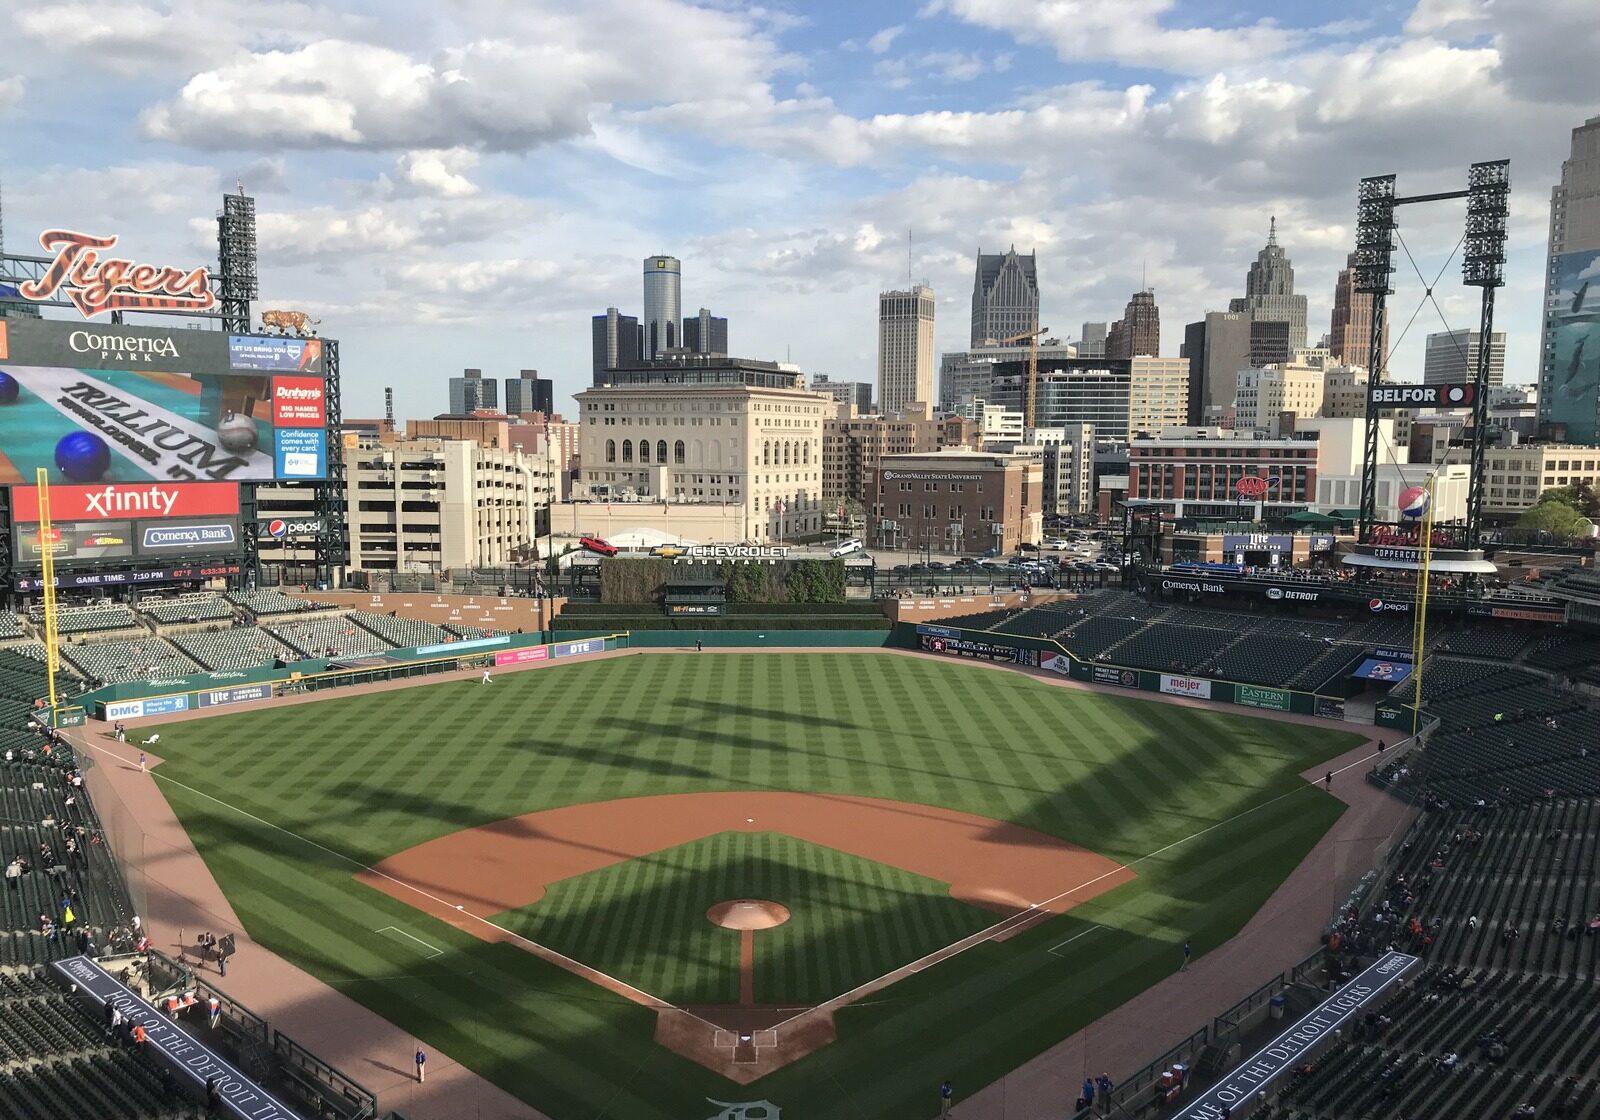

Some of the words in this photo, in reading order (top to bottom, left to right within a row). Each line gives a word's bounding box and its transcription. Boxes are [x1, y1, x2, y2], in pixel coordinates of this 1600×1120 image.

[20, 229, 215, 318] Tigers
[1223, 313, 1239, 321] 1001
[101, 352, 153, 362] PARK
[276, 386, 321, 398] Dunham's
[1372, 388, 1437, 402] BELFOR
[60, 381, 249, 479] TRILLIUM
[280, 430, 319, 438] Confidence
[948, 473, 983, 481] UNIVERSITY
[85, 486, 179, 516] xfinity
[287, 520, 321, 535] pepsi
[201, 529, 228, 539] Bank
[1249, 534, 1269, 545] Lite
[692, 546, 791, 557] CHEVROLET
[76, 576, 100, 584] GAME
[103, 574, 126, 582] TIME:
[151, 571, 164, 579] PM
[1202, 583, 1225, 593] Bank
[1019, 595, 1028, 603] 42
[1285, 591, 1319, 601] DETROIT
[1383, 603, 1408, 613] pepsi
[570, 642, 590, 654] DTE
[951, 641, 976, 650] TODAY'S
[1170, 678, 1201, 691] meijer
[209, 692, 229, 705] Lite
[1241, 686, 1284, 701] EASTERN
[110, 705, 140, 717] DMC
[104, 990, 148, 1021] HOME
[143, 1019, 168, 1033] OF
[160, 1032, 194, 1056] THE
[187, 1054, 259, 1104] DETROIT
[1217, 1083, 1244, 1102] OF
[1238, 1060, 1276, 1083] THE
[1267, 1015, 1331, 1061] DETROIT
[1321, 984, 1372, 1015] TIGERS
